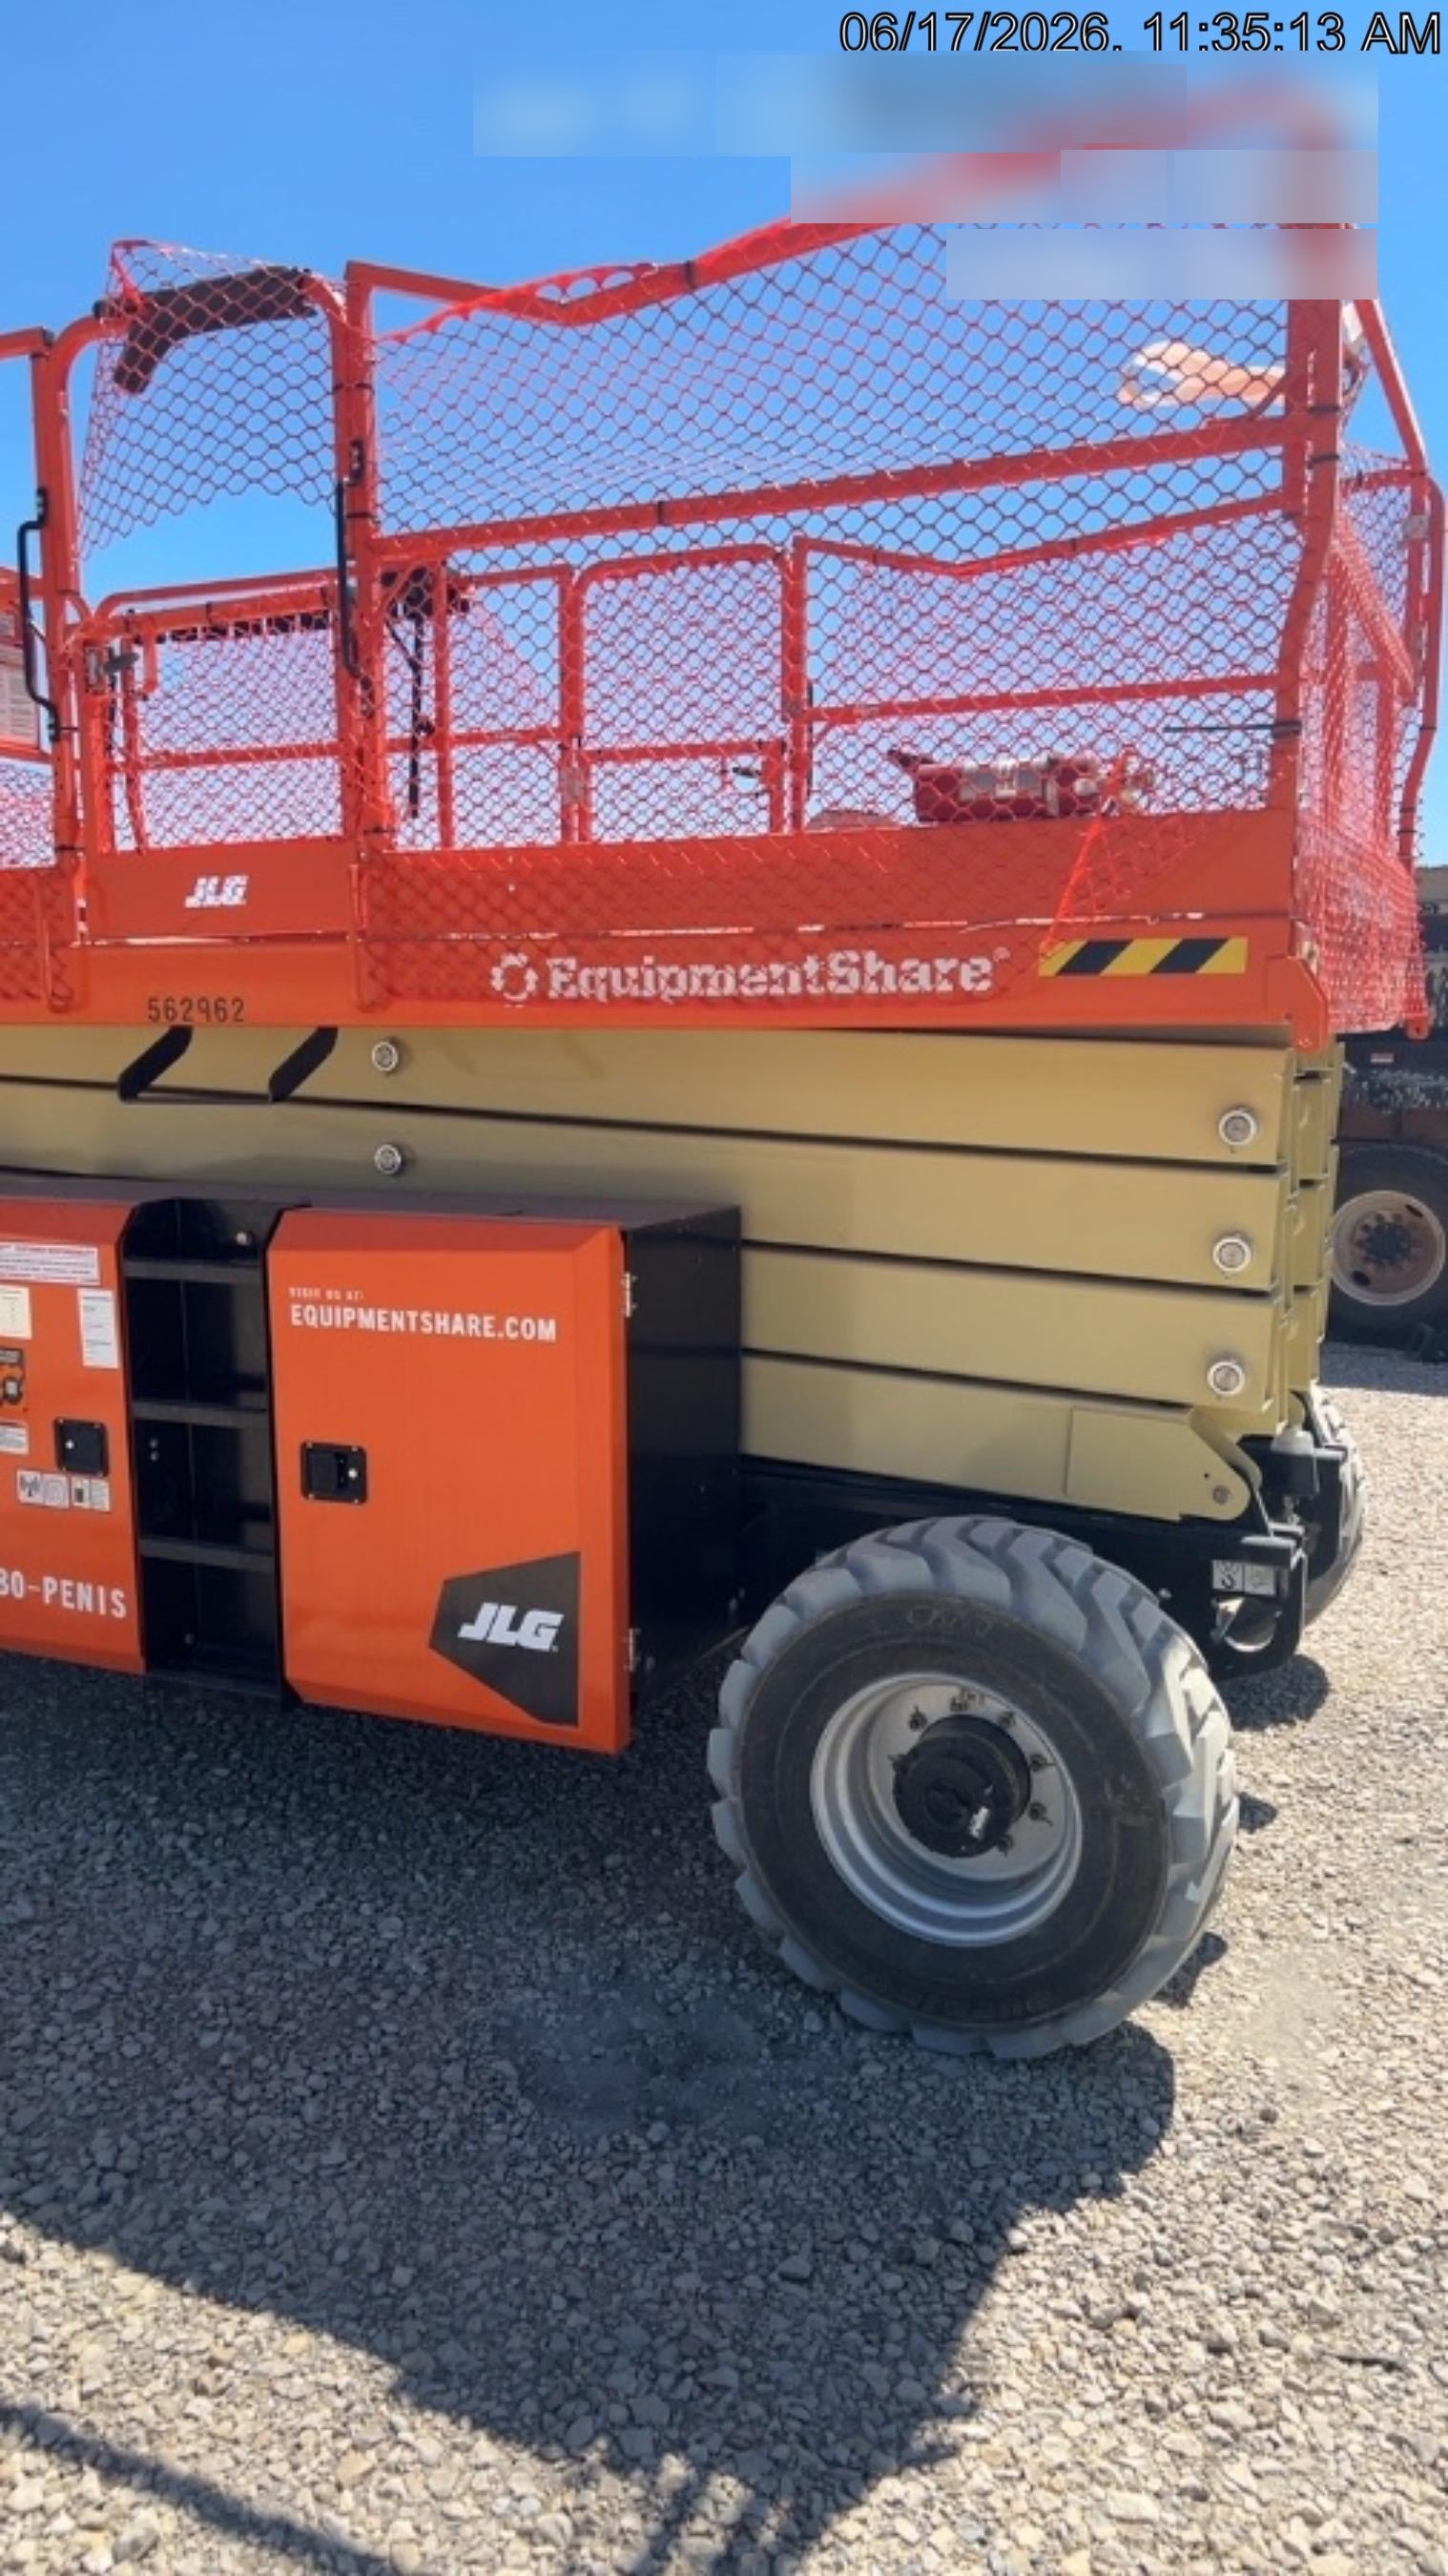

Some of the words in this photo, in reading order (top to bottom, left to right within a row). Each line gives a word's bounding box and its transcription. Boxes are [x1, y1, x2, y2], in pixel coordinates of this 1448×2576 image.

[185, 875, 250, 908] JLG
[147, 996, 245, 1024] 562962
[290, 1303, 557, 1342] EQUIPMENTSHARE.COM
[457, 1602, 565, 1652] JLG
